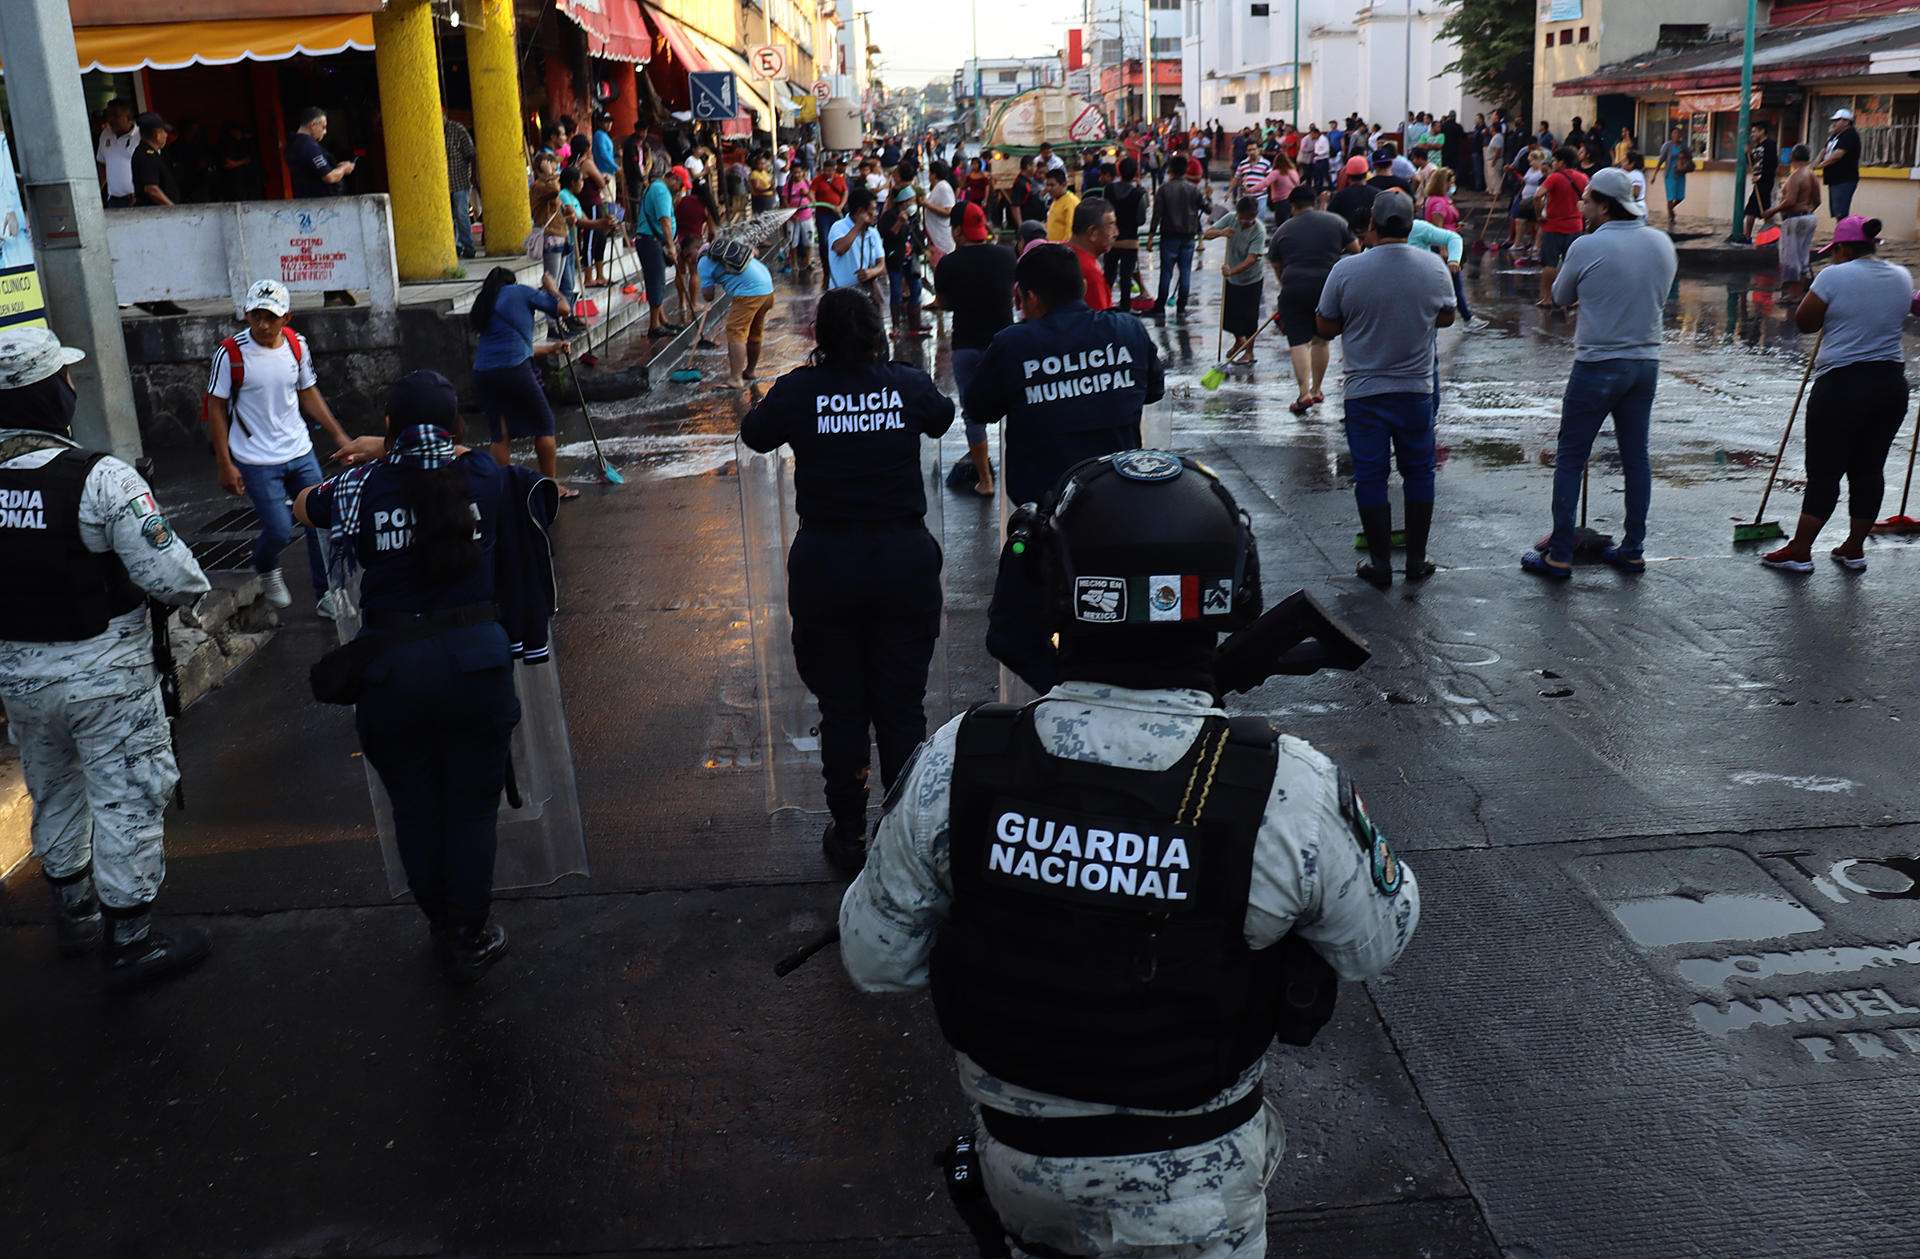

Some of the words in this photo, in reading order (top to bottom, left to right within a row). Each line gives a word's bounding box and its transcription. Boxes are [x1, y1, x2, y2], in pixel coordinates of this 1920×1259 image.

[1023, 342, 1133, 379] POLICÍA
[816, 386, 904, 414] POLICÍA
[1025, 369, 1136, 405] MUNICIPAL
[817, 411, 906, 434] MUNICIPAL
[1079, 579, 1107, 588] HECHO
[1109, 580, 1123, 589] EN
[1083, 611, 1118, 620] MEXICO
[996, 811, 1190, 870] GUARDIA
[988, 843, 1188, 900] NACIONAL
